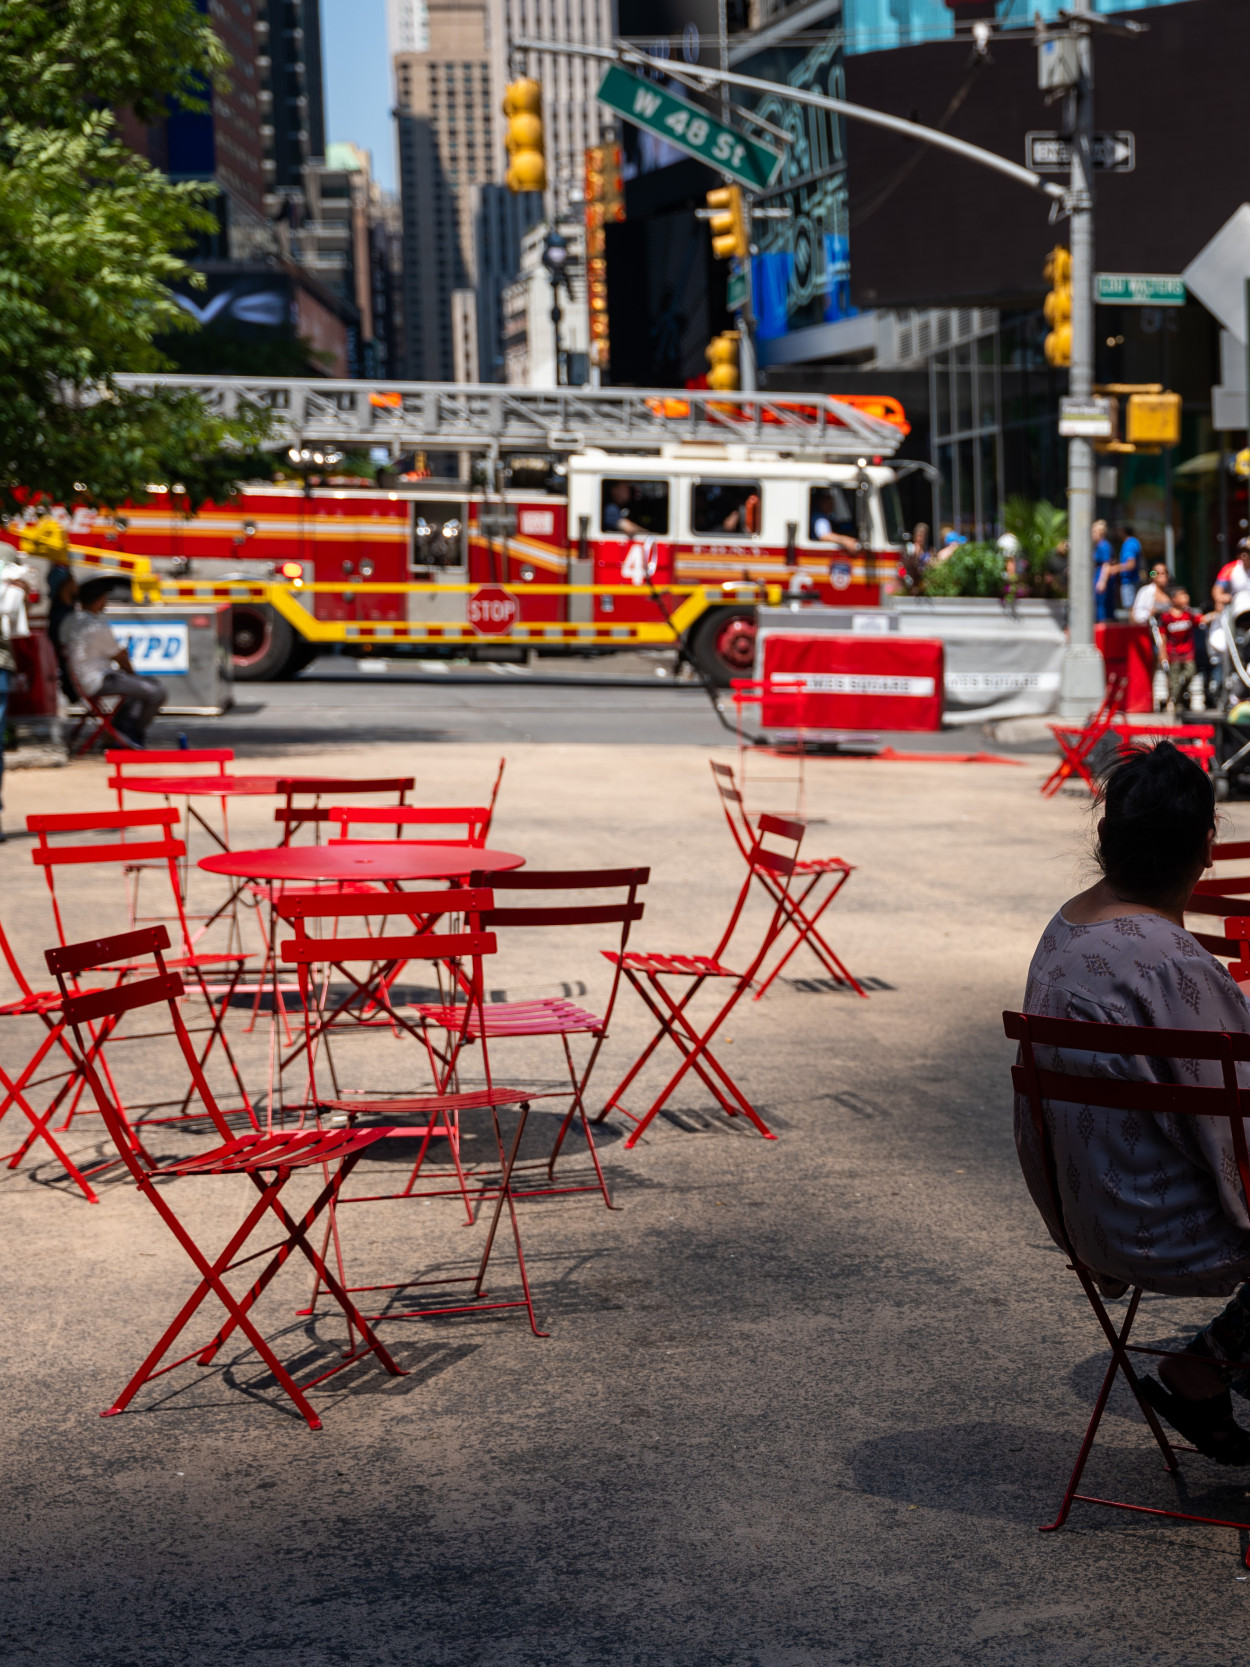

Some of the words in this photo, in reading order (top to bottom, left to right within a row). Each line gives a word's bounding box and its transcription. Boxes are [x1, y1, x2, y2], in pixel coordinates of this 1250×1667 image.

[633, 87, 662, 118] W
[664, 110, 710, 146] 48
[711, 132, 747, 168] St
[470, 600, 516, 622] STOP
[117, 636, 182, 659] YPD
